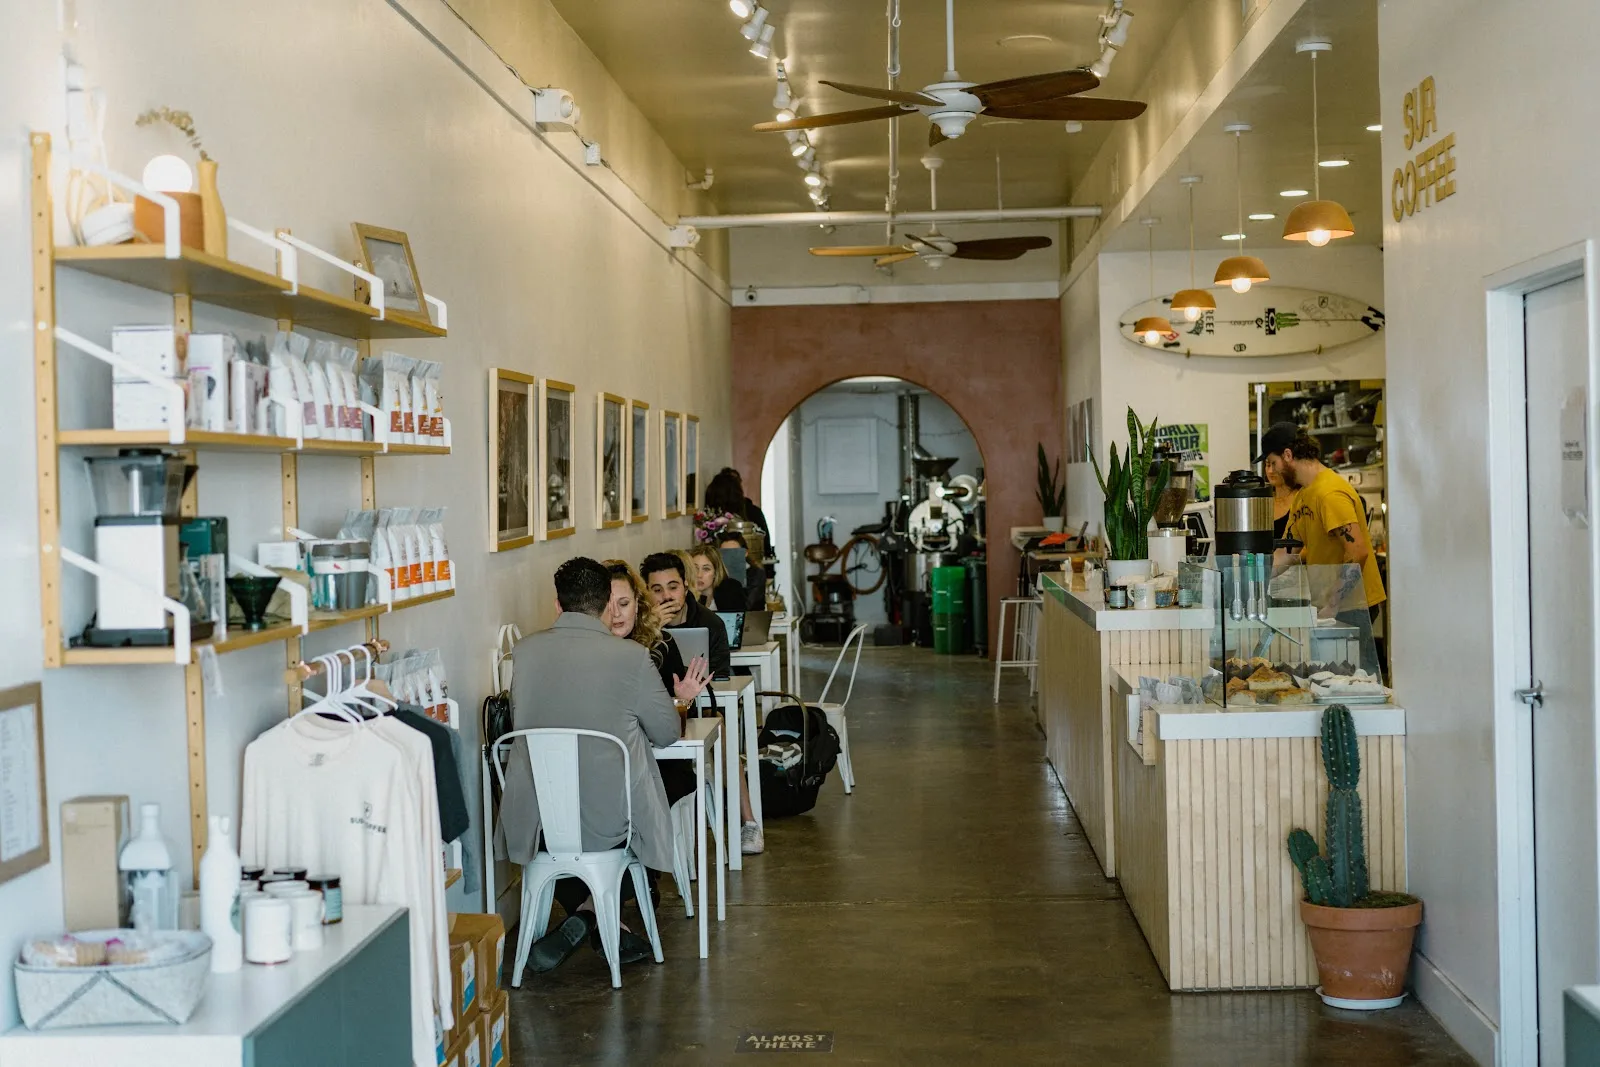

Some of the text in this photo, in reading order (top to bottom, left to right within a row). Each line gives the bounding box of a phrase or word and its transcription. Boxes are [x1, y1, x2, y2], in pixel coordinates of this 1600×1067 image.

[1403, 75, 1437, 150] SUR
[1392, 131, 1456, 223] COFFEE
[746, 1034, 826, 1042] ALMOST
[753, 1041, 816, 1049] THERE
